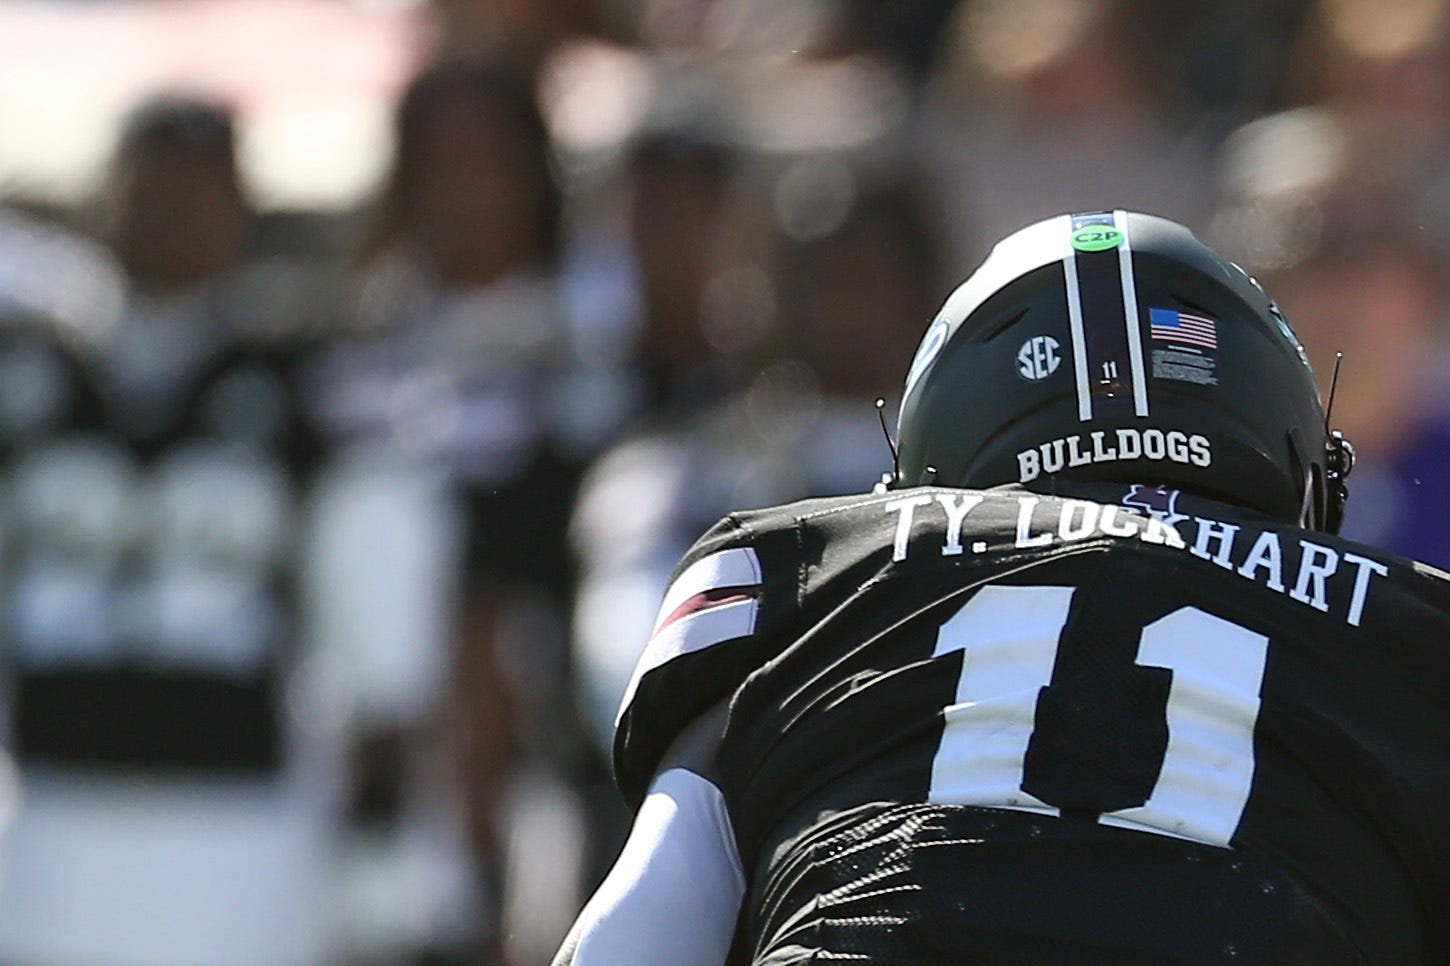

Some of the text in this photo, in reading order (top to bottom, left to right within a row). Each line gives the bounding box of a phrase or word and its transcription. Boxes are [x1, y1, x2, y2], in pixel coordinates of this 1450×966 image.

[1074, 231, 1119, 243] C2P
[1017, 335, 1063, 381] SEC
[1101, 361, 1118, 379] 11
[1016, 428, 1212, 484] BULLDOGS
[885, 493, 1389, 628] TY. LOCKHART
[927, 584, 1270, 851] 11
